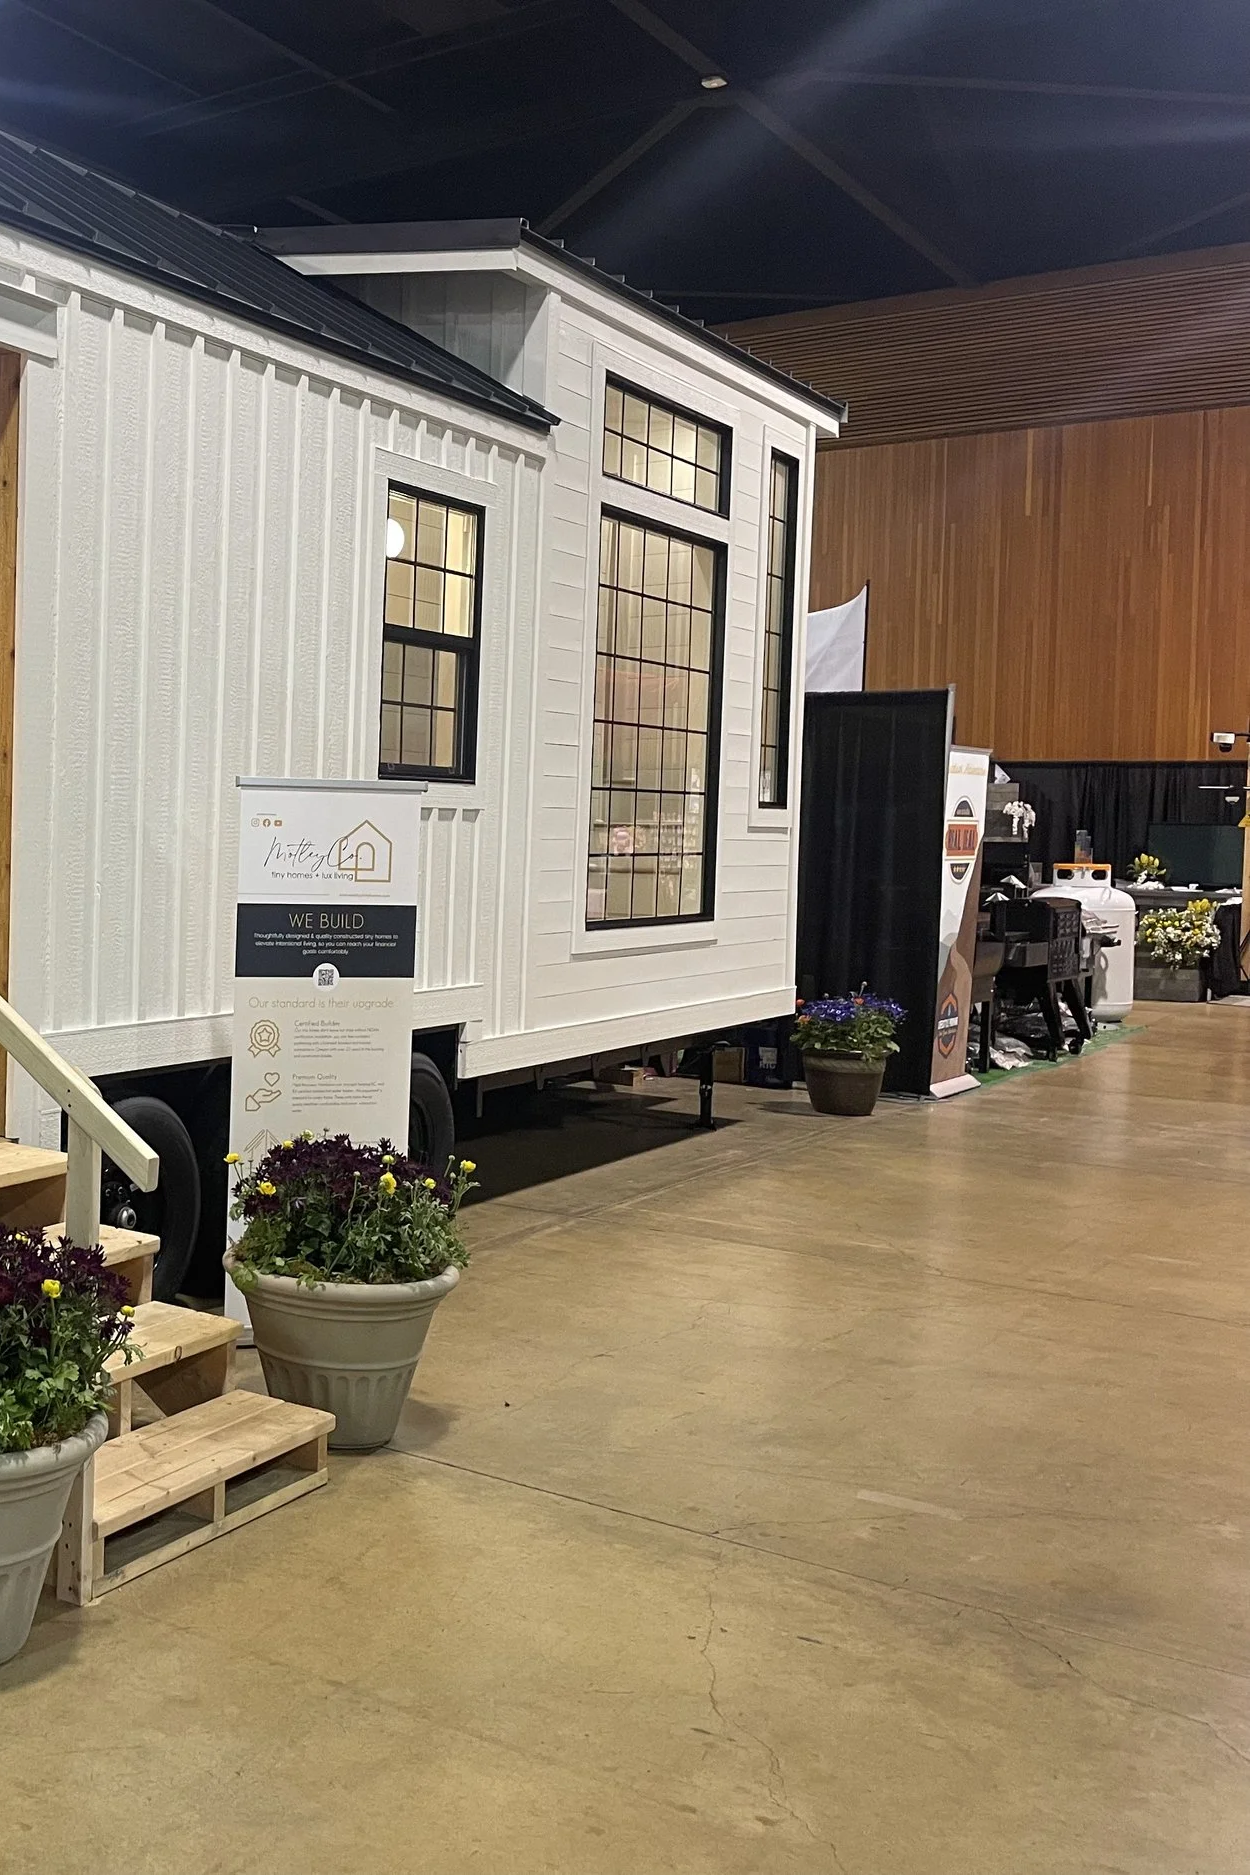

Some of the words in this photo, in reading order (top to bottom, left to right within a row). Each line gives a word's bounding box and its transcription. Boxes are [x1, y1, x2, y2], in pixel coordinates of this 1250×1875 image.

[271, 871, 284, 880] tiny
[286, 871, 312, 880] homes
[321, 871, 332, 880] lux
[334, 871, 354, 881] living
[288, 913, 313, 929] WE
[320, 913, 364, 929] BUILD
[315, 933, 332, 941] quality
[248, 996, 269, 1009] Our
[271, 997, 316, 1009] standard
[318, 998, 326, 1009] is
[328, 996, 350, 1009] their
[352, 996, 395, 1011] upgrade
